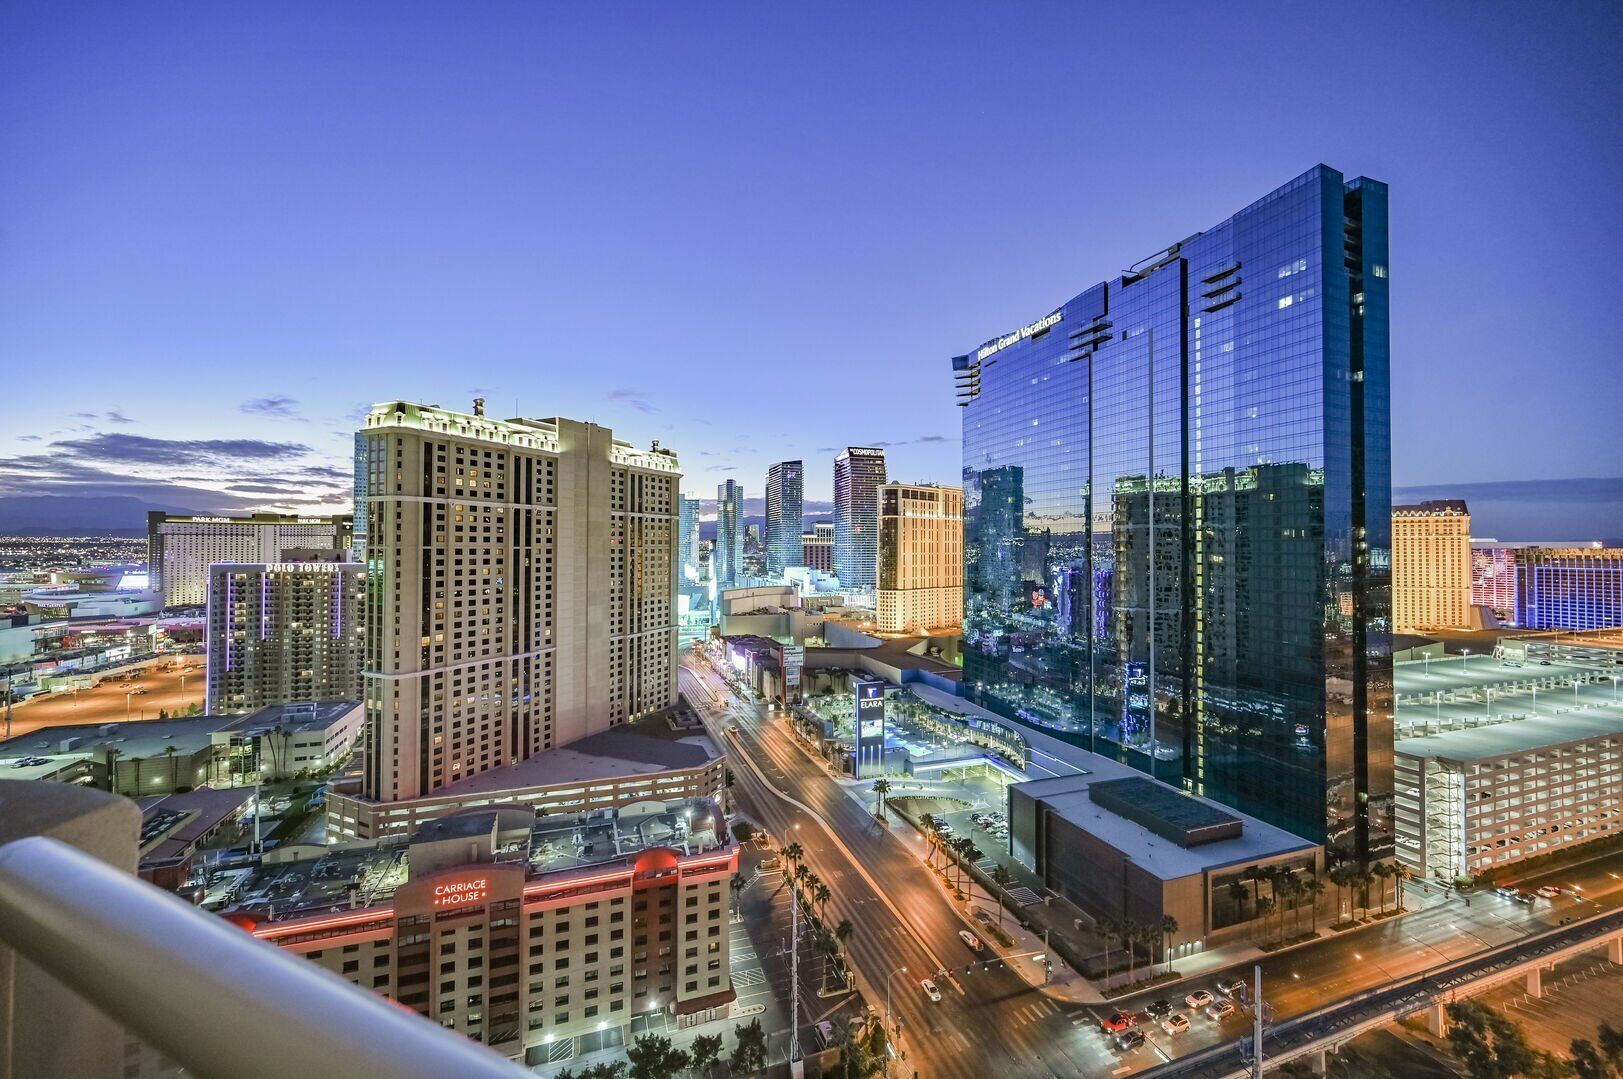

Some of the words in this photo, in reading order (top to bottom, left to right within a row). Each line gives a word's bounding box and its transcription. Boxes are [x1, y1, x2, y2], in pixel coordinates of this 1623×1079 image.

[978, 344, 998, 360] Hilton
[998, 330, 1020, 350] Grand
[1020, 312, 1062, 338] Vacations
[853, 449, 885, 457] COSMOPOLITAN
[266, 563, 294, 572] POLO
[298, 563, 340, 572] TOWERS
[861, 700, 883, 709] ELARA
[435, 880, 486, 895] CARRIAGE
[442, 892, 479, 905] HOUSE
